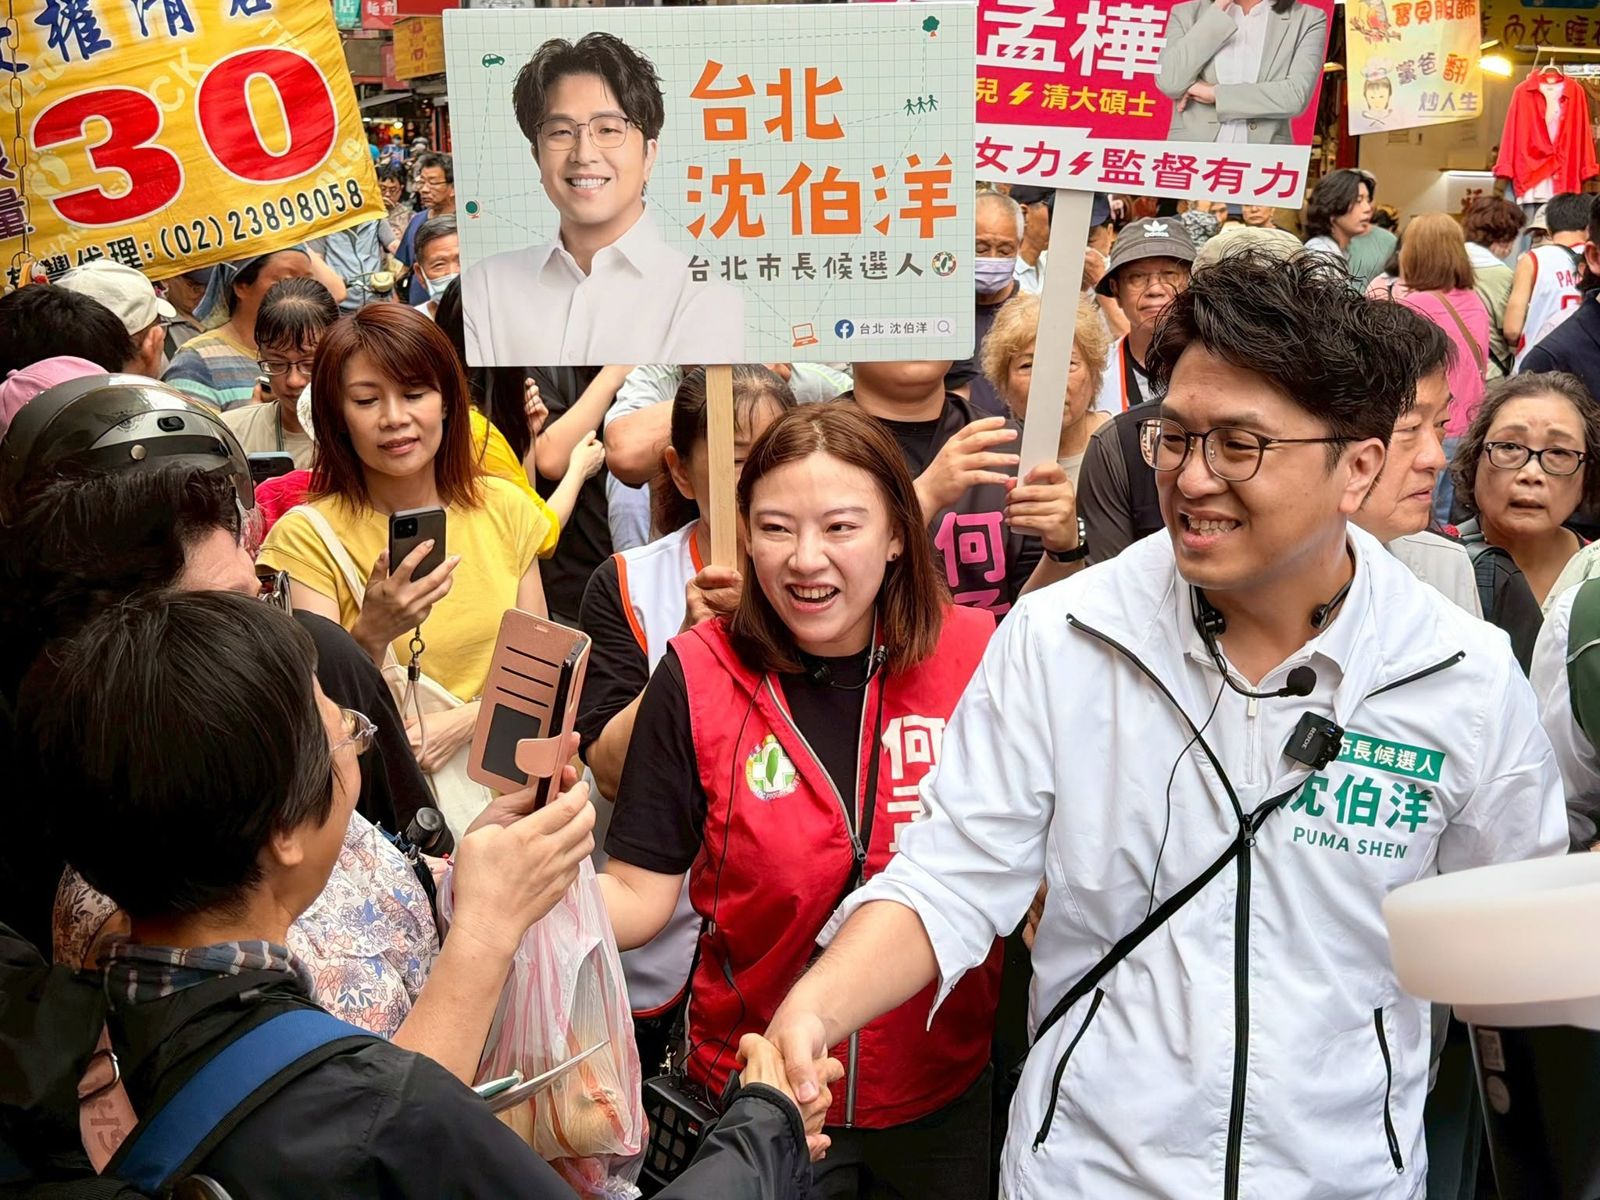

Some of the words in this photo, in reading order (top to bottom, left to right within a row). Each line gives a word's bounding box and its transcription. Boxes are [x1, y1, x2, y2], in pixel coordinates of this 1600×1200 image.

[689, 60, 845, 142] 台北
[1041, 83, 1156, 117] 清大碩士
[1418, 91, 1478, 111] 炒人生
[33, 48, 338, 227] 30
[976, 136, 1061, 178] 女力
[1097, 147, 1300, 198] 監督有力
[686, 152, 958, 240] 沈伯洋
[687, 250, 924, 282] 台北市長候選人
[860, 322, 885, 335] 台北
[889, 321, 929, 335] 沈伯洋
[1292, 826, 1350, 853] PUMA
[1356, 839, 1409, 860] SHEN
